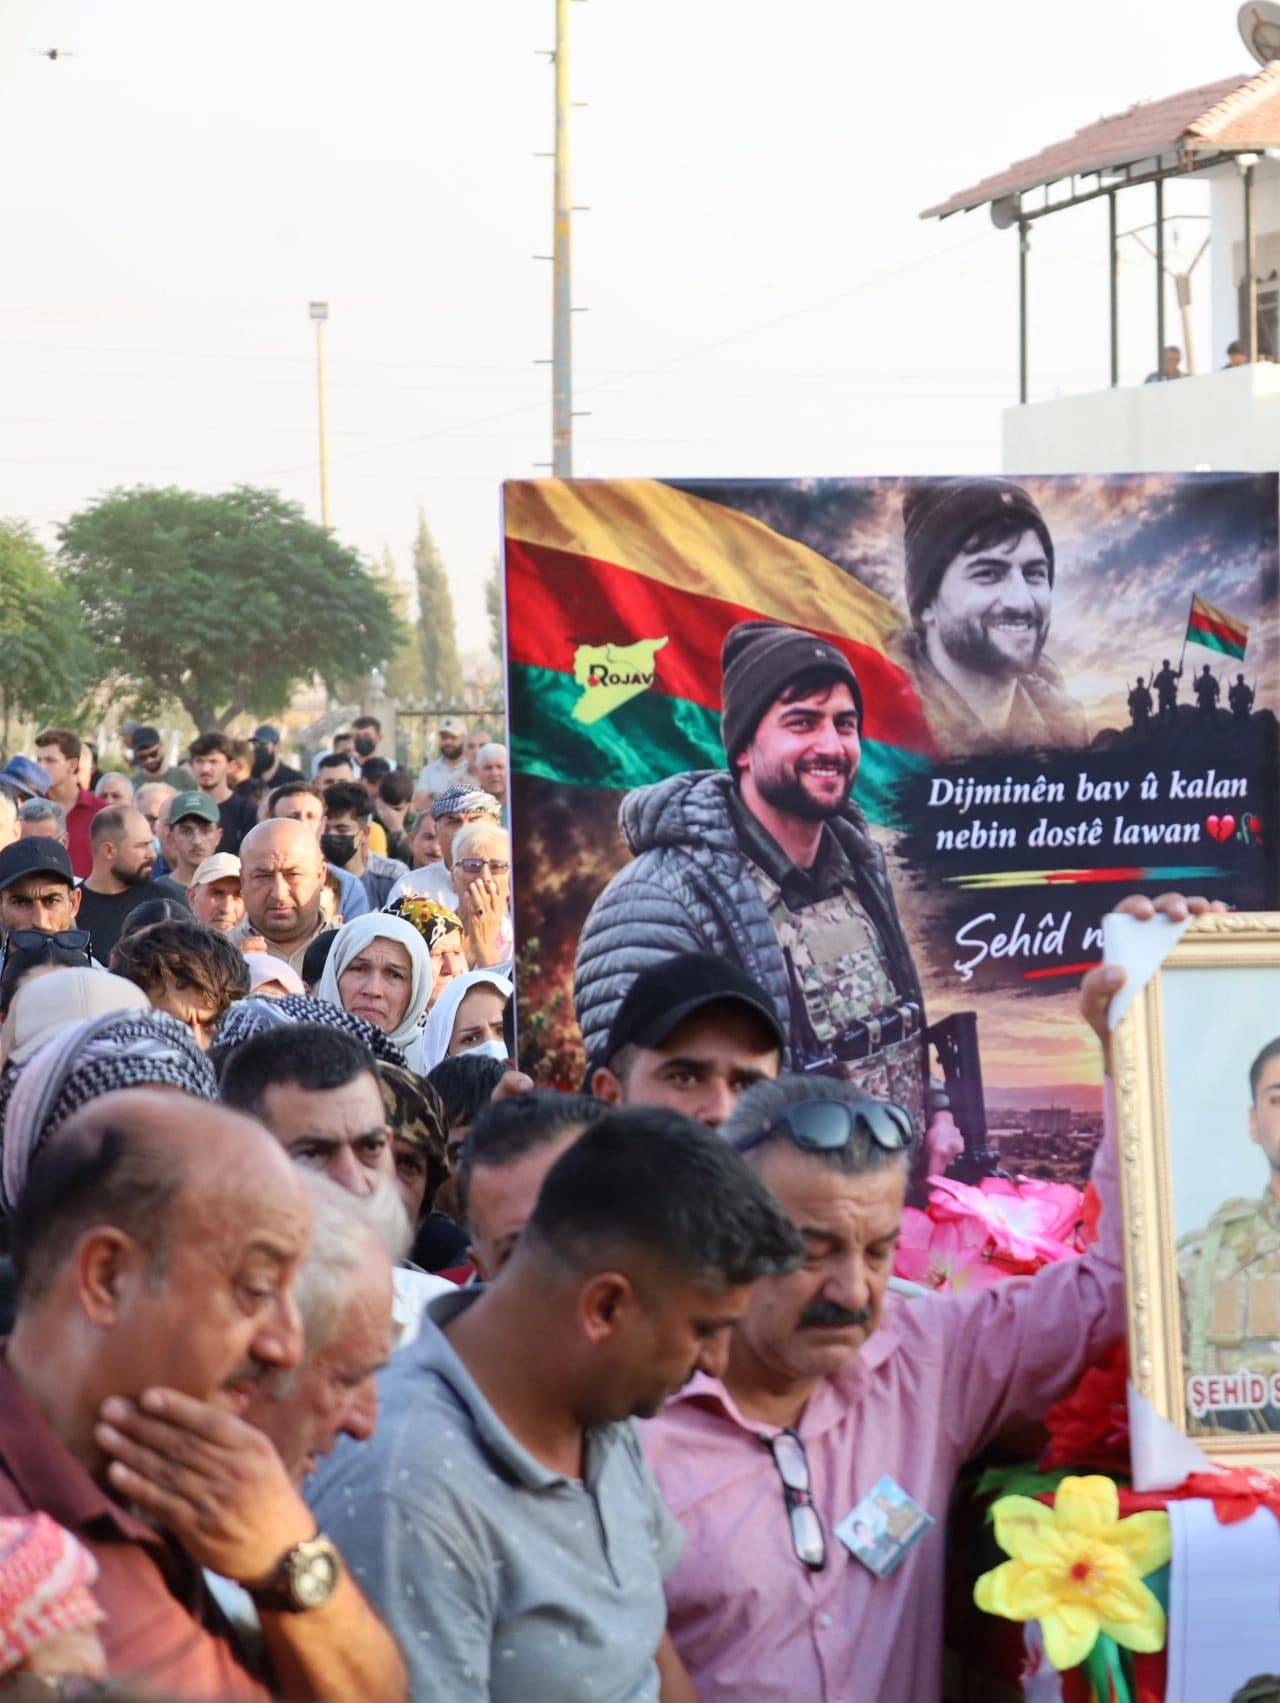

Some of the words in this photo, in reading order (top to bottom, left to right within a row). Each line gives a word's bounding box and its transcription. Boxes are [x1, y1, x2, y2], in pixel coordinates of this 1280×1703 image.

[928, 774, 1065, 814] Dijminên
[1076, 773, 1129, 801] bav
[1140, 772, 1158, 800] û
[1169, 769, 1248, 799] kalan
[936, 819, 1016, 850] nebin
[1028, 817, 1104, 847] dostê
[1113, 815, 1200, 845] lawan
[954, 910, 1073, 982] Şehîd
